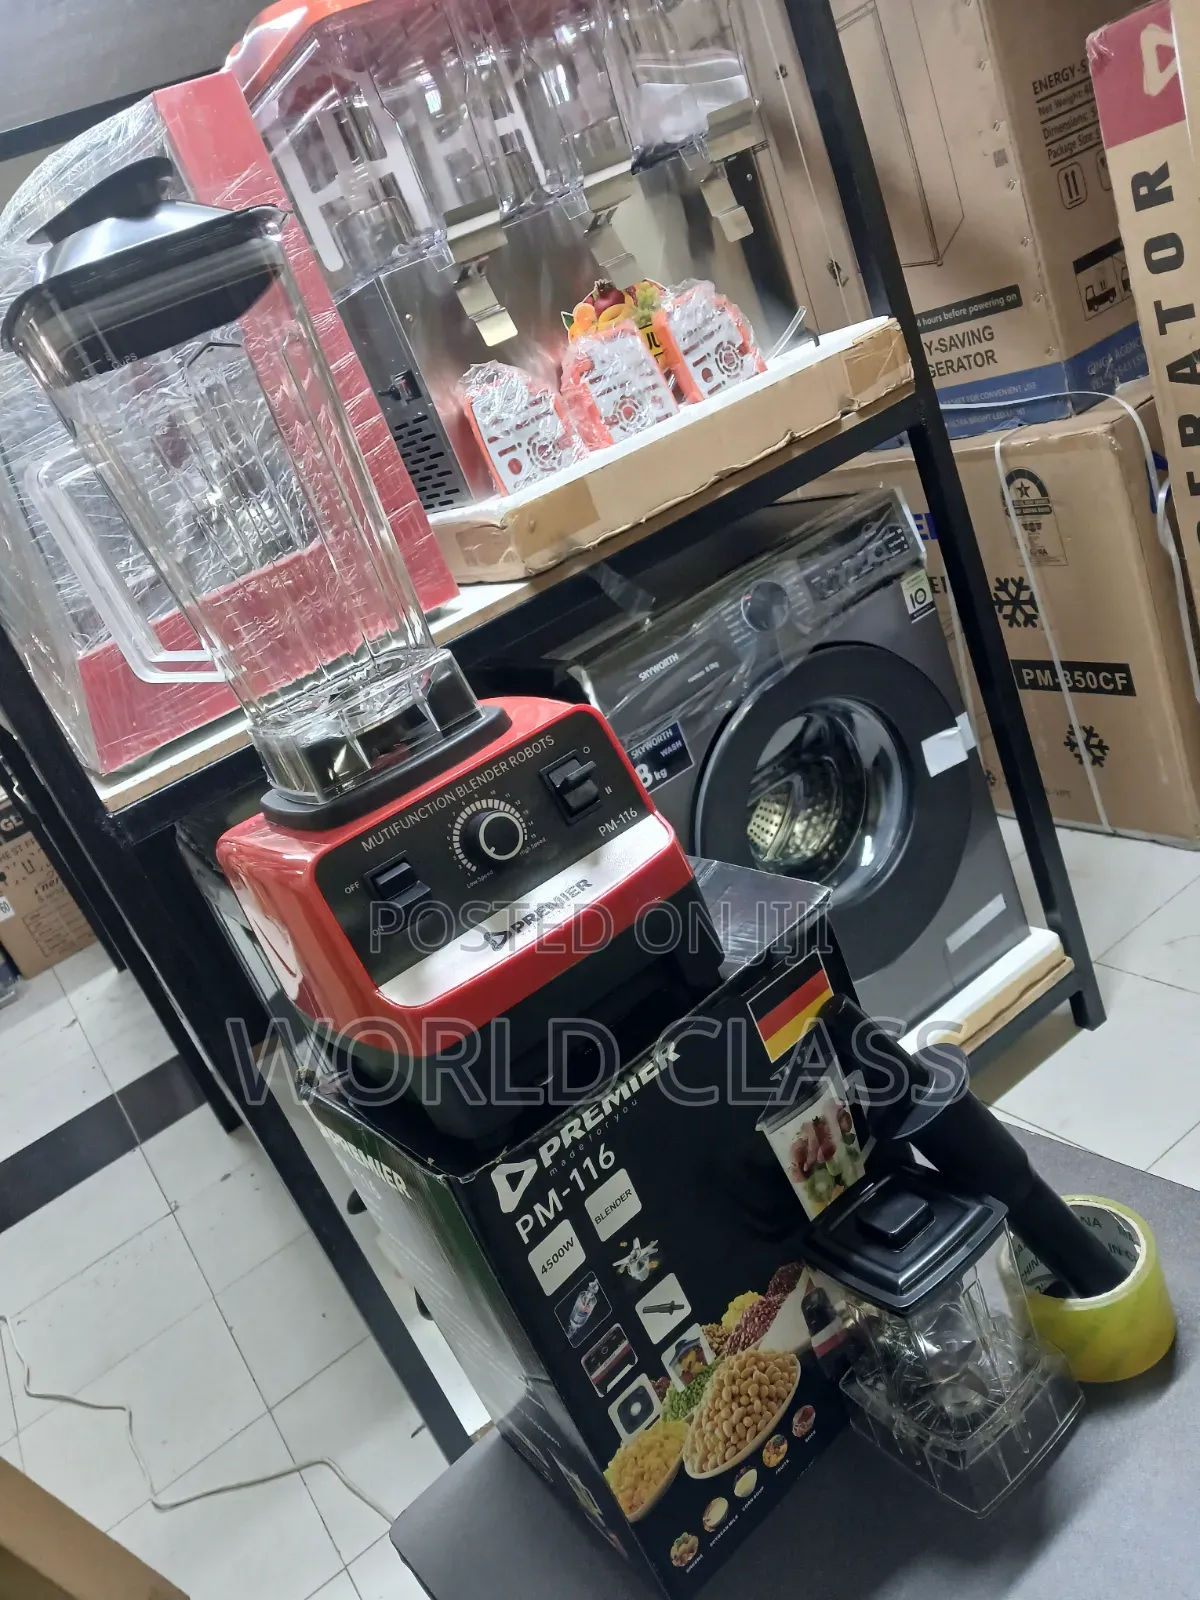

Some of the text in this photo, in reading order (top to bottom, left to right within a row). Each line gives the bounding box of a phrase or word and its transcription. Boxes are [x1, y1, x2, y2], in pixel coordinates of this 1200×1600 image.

[1032, 59, 1087, 95] ENERGY-S
[922, 314, 943, 326] hours
[942, 307, 967, 320] before
[968, 296, 1005, 316] powering
[1006, 293, 1018, 302] on
[923, 325, 995, 356] Y-SAVING
[639, 653, 679, 682] SKYWORTH
[631, 728, 674, 760] SKYWORTH
[660, 740, 683, 757] WASH
[635, 763, 668, 788] 8 kg
[361, 735, 556, 852] MUTIFUNCTION BLENDER ROBOTS
[598, 808, 638, 837] PM-116
[531, 837, 547, 850] Speed
[344, 881, 360, 895] OFF
[466, 870, 494, 889] Low Speed
[538, 1041, 681, 1169] PREMIER
[549, 1143, 585, 1177] made
[613, 1099, 638, 1123] you
[515, 1143, 616, 1245] PM-116
[594, 1188, 633, 1226] BLENDER
[540, 1237, 576, 1276] 4500W
